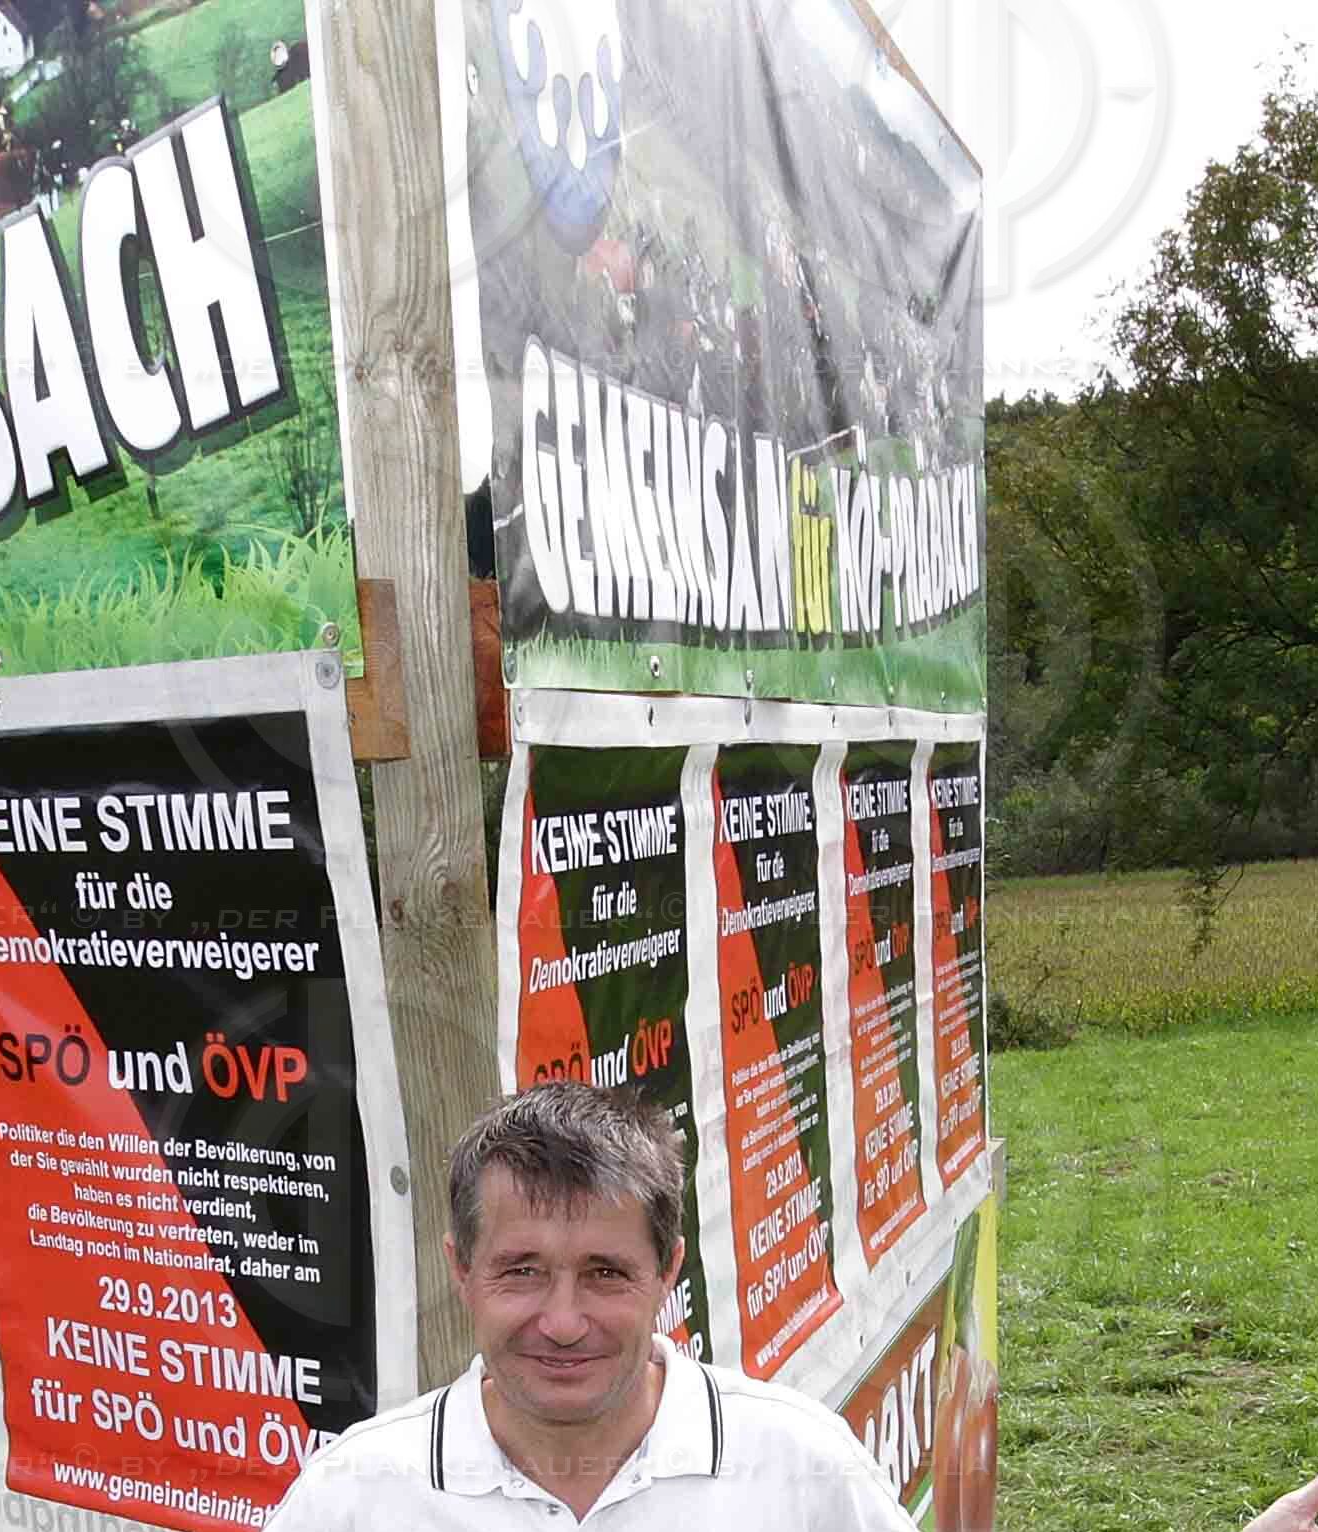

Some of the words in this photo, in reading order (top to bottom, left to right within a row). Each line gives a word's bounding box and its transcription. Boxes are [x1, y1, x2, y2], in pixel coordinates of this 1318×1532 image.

[791, 456, 831, 634] für
[97, 791, 294, 852] STIMME
[531, 814, 603, 875] KEINE
[604, 806, 677, 864] STIMME
[720, 797, 763, 843] KEINE
[766, 792, 813, 837] STIMME
[75, 872, 117, 909] für
[127, 872, 173, 909] die
[593, 886, 612, 921] für
[617, 882, 637, 915] die
[529, 927, 681, 993] Demokratieverweigerer
[763, 973, 787, 1021] und
[107, 1042, 193, 1093] und
[202, 1032, 307, 1102] ÖVP
[591, 1033, 630, 1088] und
[633, 1016, 672, 1077] ÖVP
[10, 1150, 32, 1168] der
[36, 1151, 57, 1171] Sie
[61, 1157, 109, 1178] gewählt
[112, 1163, 172, 1184] wurden
[177, 1168, 219, 1189] nicht
[224, 1173, 329, 1201] respektieren,
[57, 1129, 76, 1148] die
[79, 1131, 104, 1150] den
[108, 1133, 158, 1155] Willen
[164, 1138, 191, 1157] der
[195, 1140, 299, 1170] Bevölkerung,
[303, 1152, 335, 1171] von
[28, 1203, 47, 1221] die
[51, 1207, 132, 1237] Bevölkerung
[138, 1221, 154, 1238] zu
[159, 1222, 238, 1249] vertreten,
[243, 1230, 294, 1252] weder
[299, 1235, 318, 1255] im
[75, 1183, 112, 1205] haben
[116, 1192, 132, 1208] es
[138, 1190, 178, 1212] nicht
[182, 1196, 256, 1222] verdient,
[30, 1230, 83, 1255] Landtag
[87, 1239, 120, 1258] noch
[124, 1244, 140, 1261] im
[144, 1247, 235, 1275] Nationalrat,
[240, 1257, 290, 1279] daher
[294, 1267, 320, 1283] am
[749, 1207, 784, 1262] KEINE
[99, 1276, 237, 1327] 29.9.2013
[47, 1317, 149, 1376] KEINE
[160, 1340, 323, 1404] STIMME
[31, 1378, 81, 1422] für
[93, 1389, 163, 1440] SPÖ
[173, 1416, 245, 1462] und
